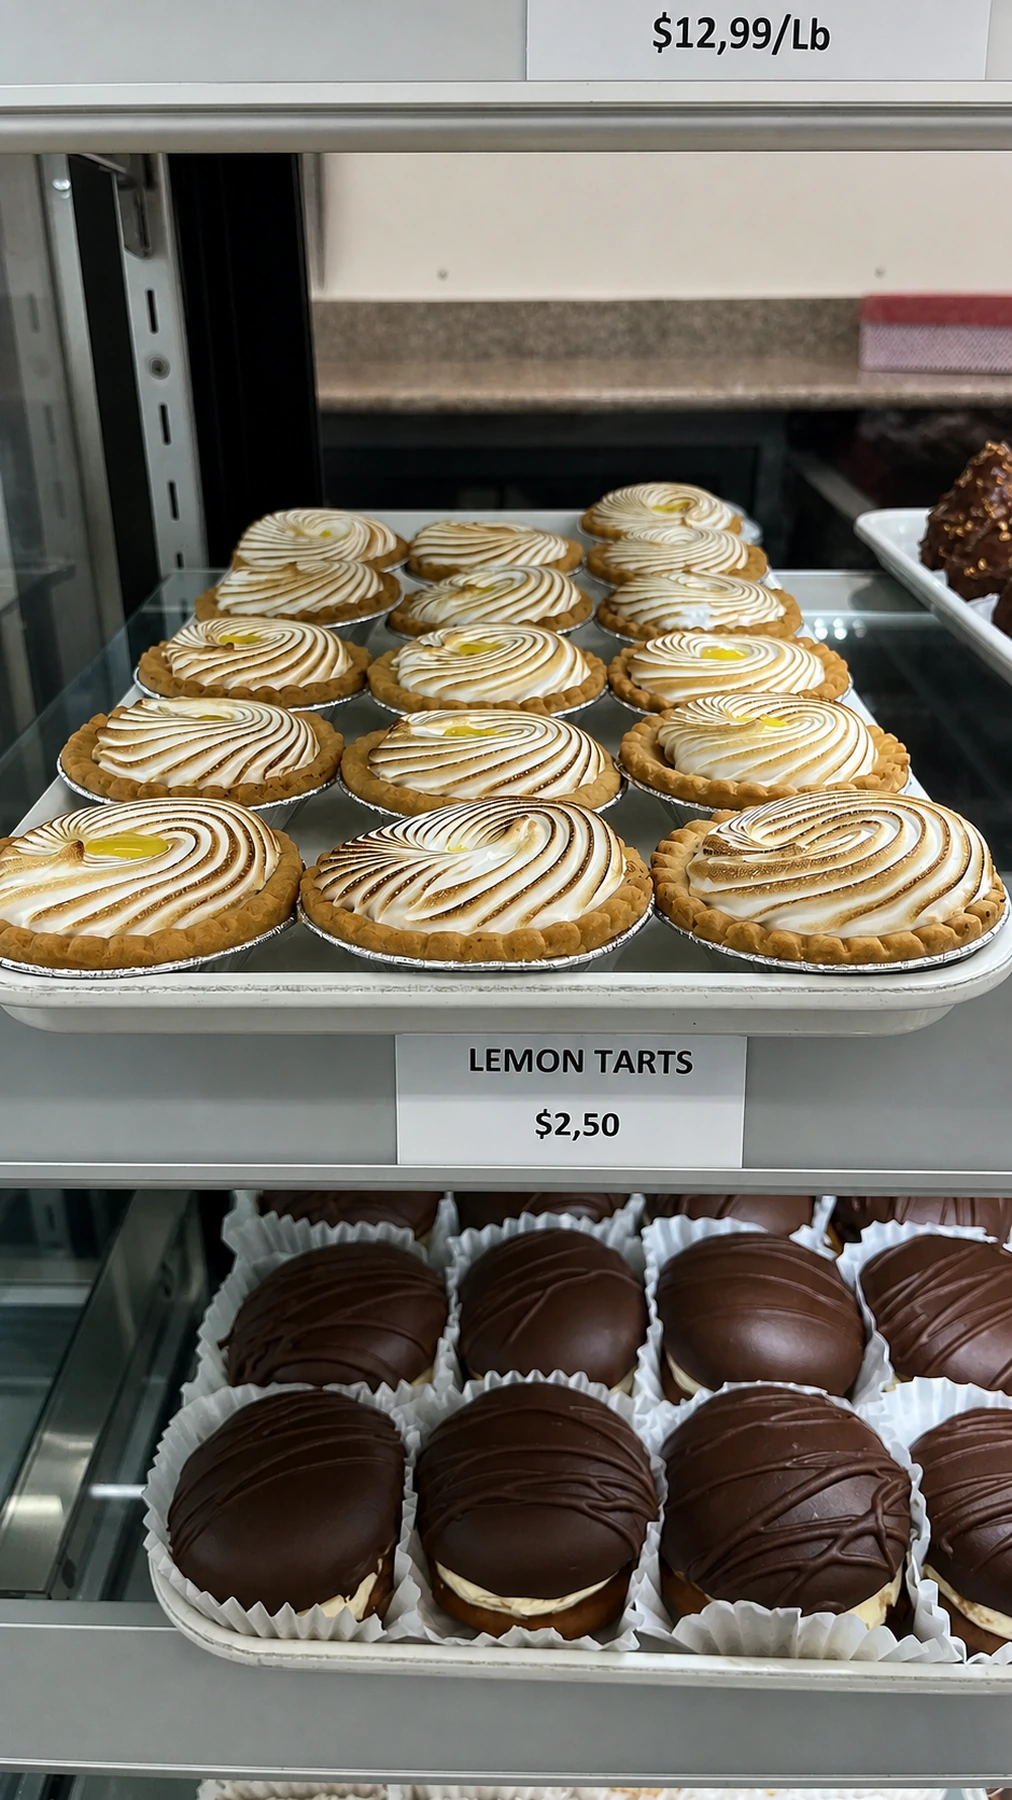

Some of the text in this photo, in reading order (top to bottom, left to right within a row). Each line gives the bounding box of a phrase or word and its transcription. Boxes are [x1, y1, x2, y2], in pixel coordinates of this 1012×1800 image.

[652, 12, 831, 56] $12,99/Lb
[469, 1047, 693, 1075] LEMON TARTS
[535, 1108, 620, 1141] $2,50
